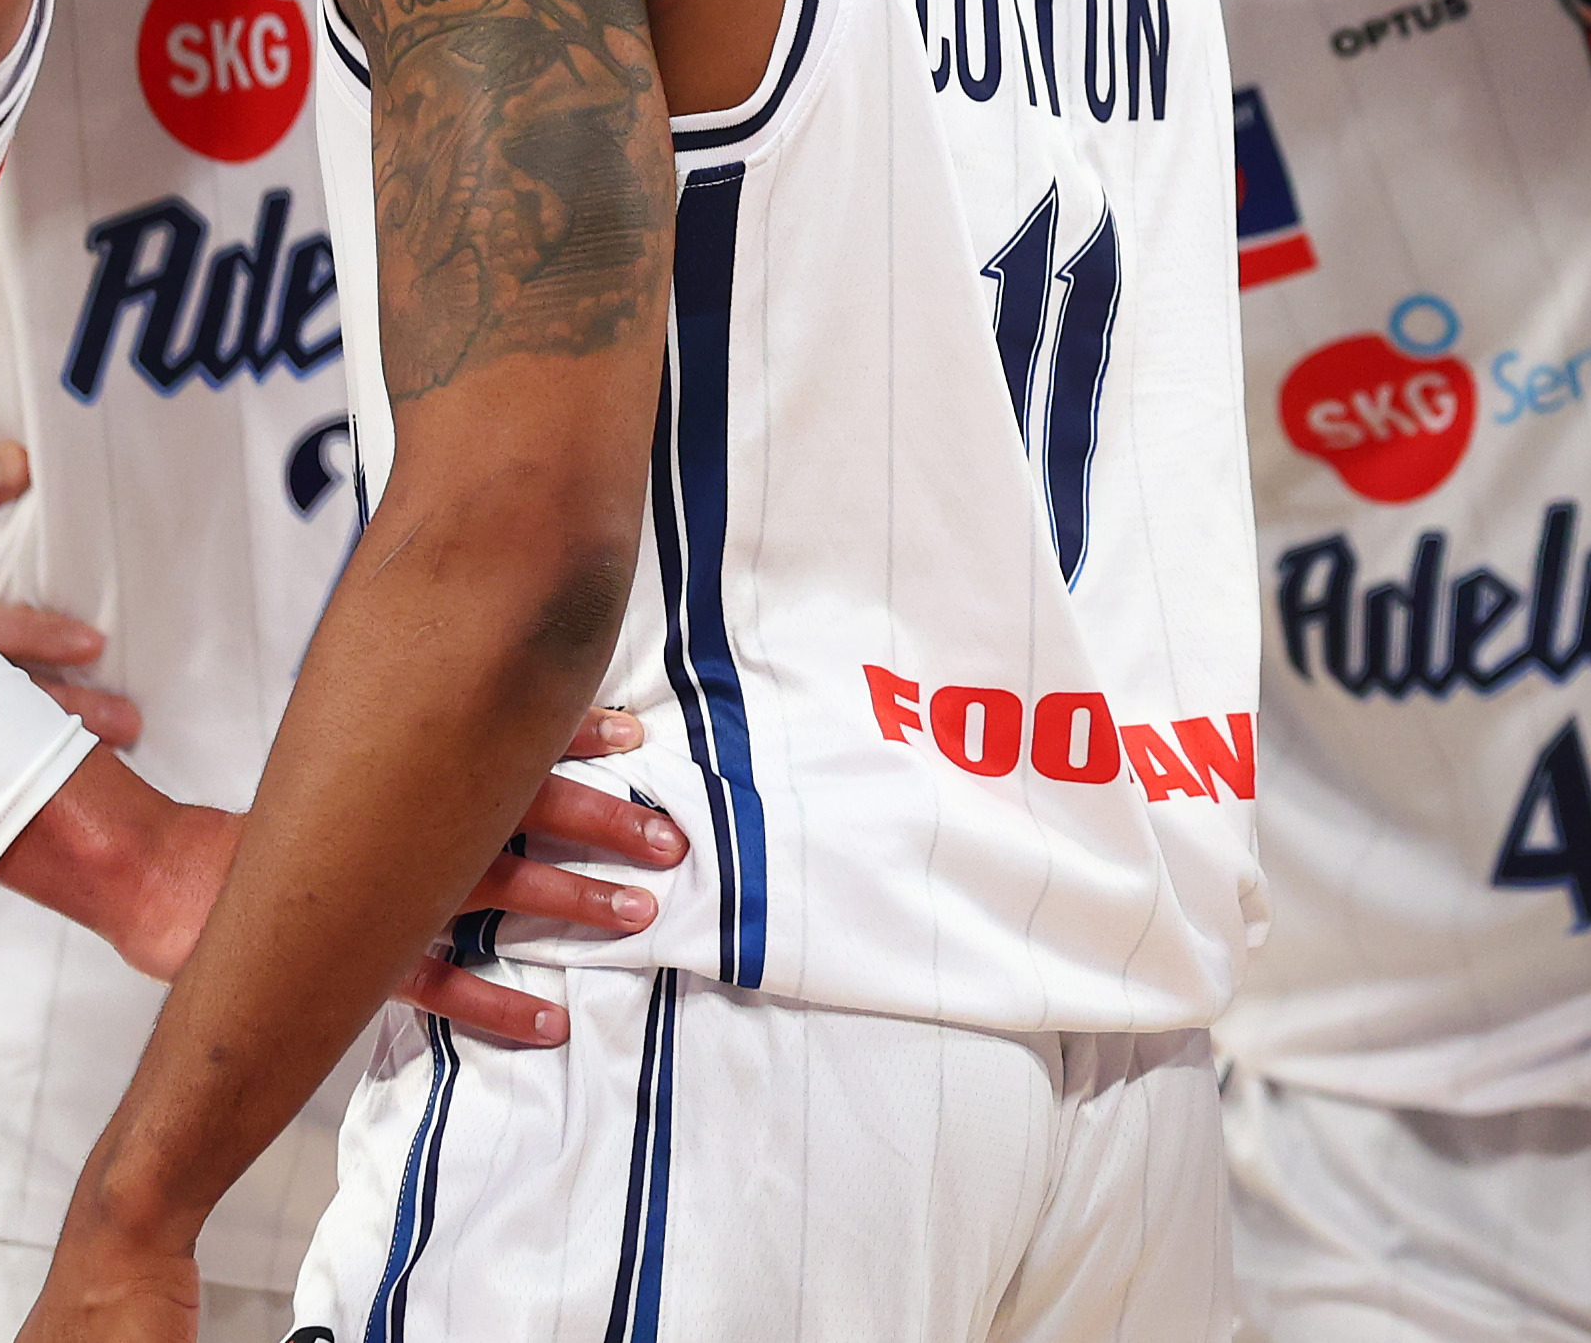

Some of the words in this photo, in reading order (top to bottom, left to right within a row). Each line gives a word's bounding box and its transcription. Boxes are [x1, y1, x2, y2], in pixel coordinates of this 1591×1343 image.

[165, 13, 291, 98] SKG
[980, 176, 1123, 595] 11
[1306, 371, 1458, 450] SKG
[863, 663, 1258, 804] FOOAN
